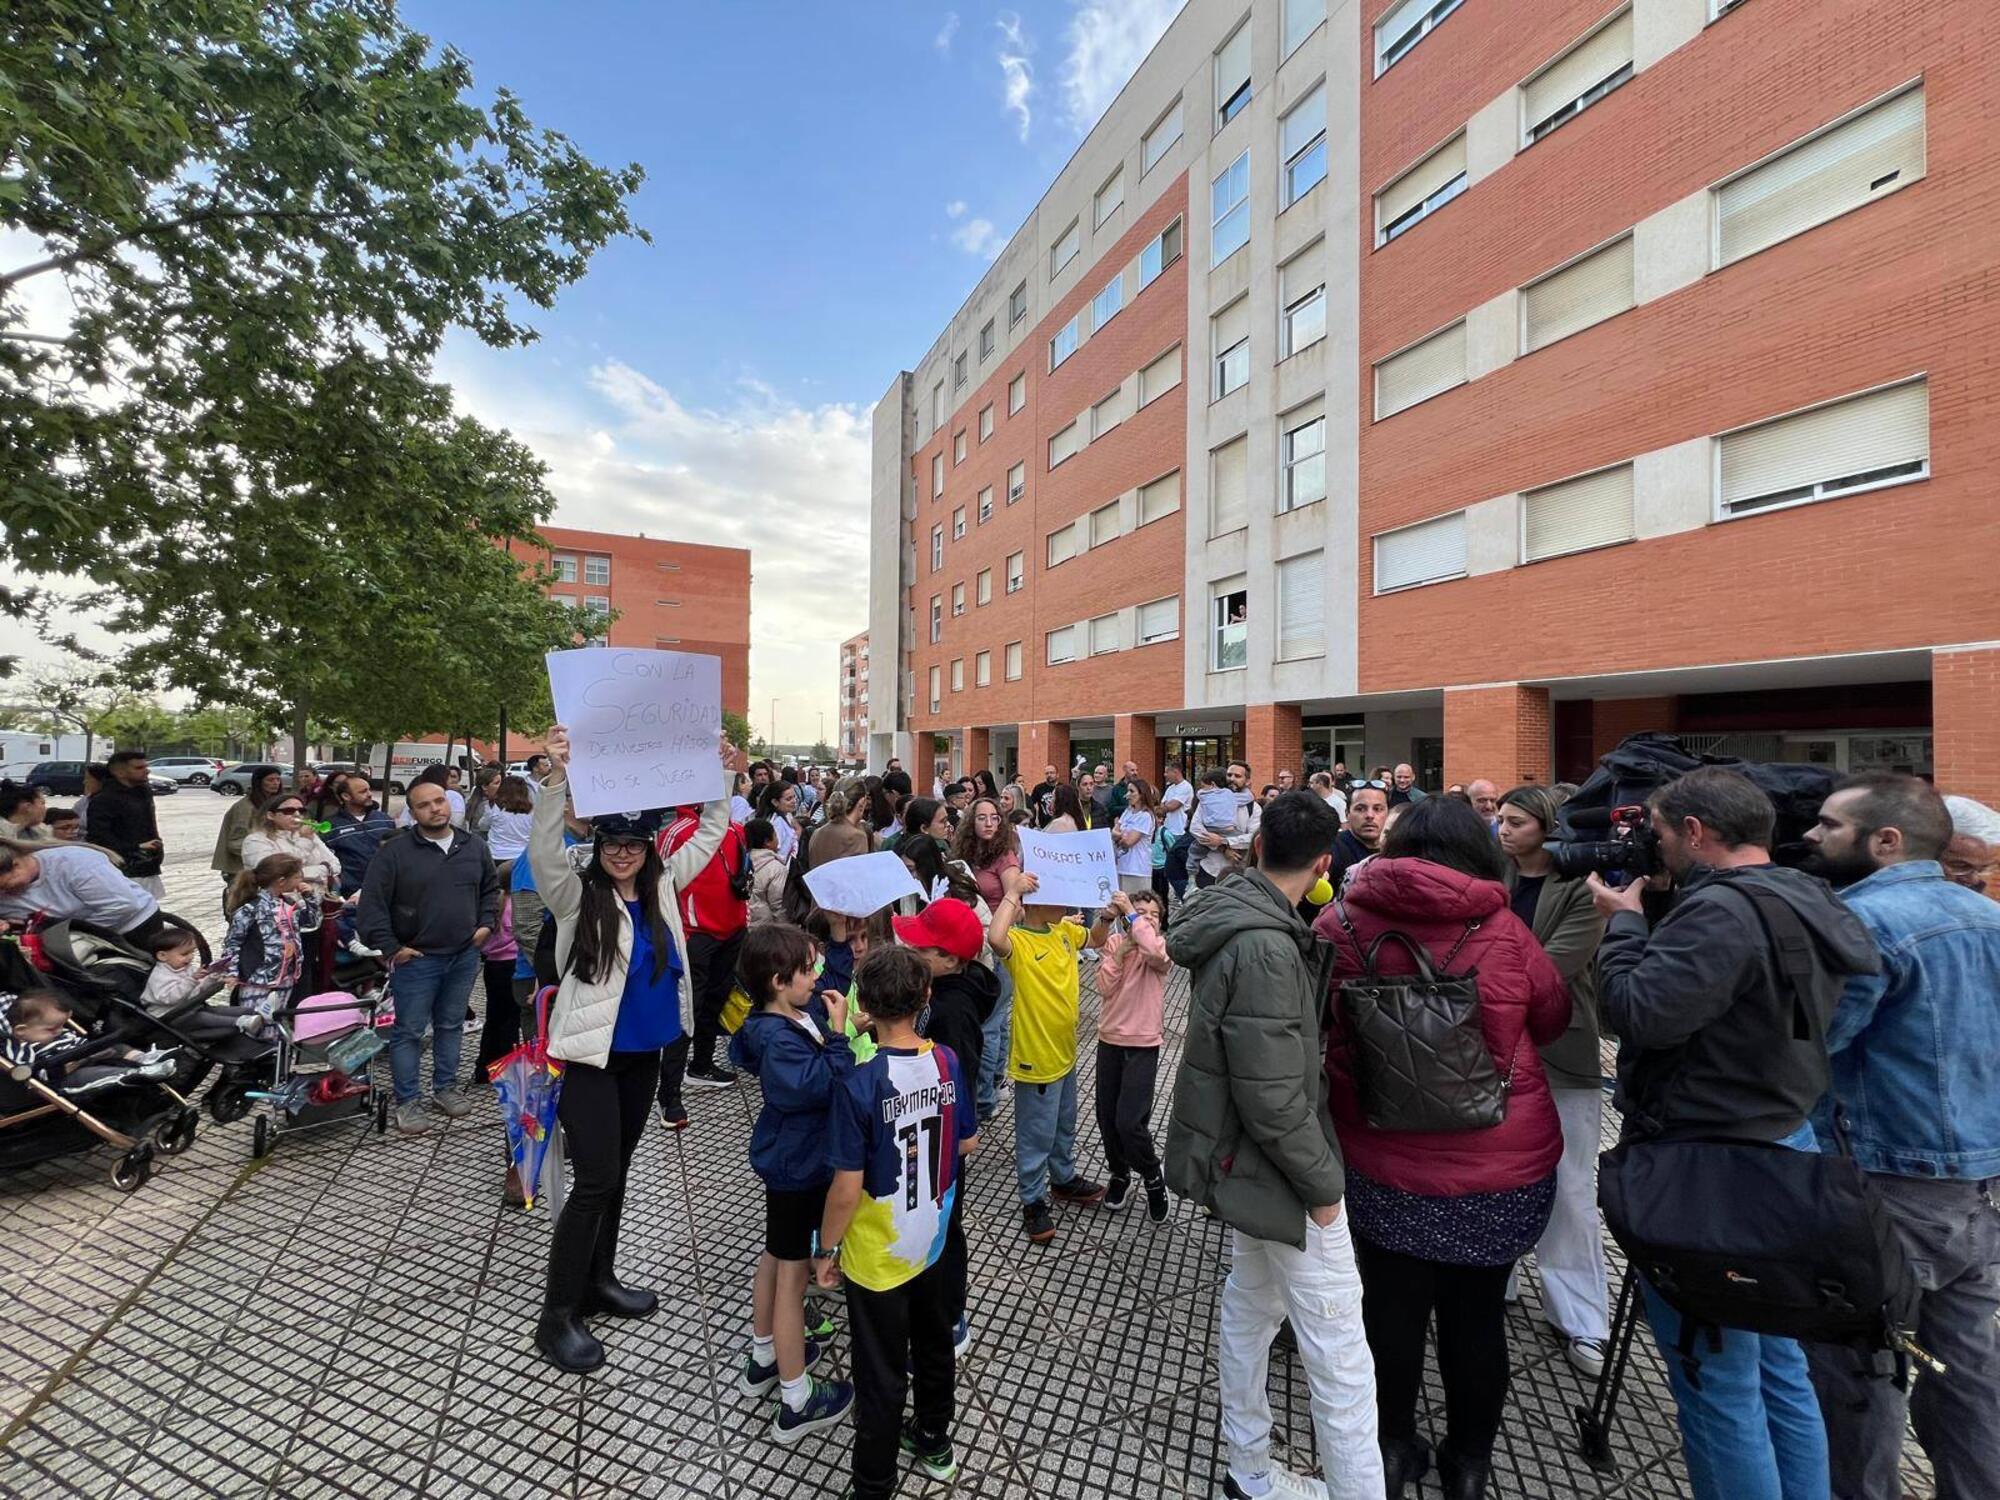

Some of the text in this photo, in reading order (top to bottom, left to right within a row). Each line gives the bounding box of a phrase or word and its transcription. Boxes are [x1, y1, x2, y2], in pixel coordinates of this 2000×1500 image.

[612, 652, 695, 680] CON LA
[589, 740, 611, 759] DE
[882, 1082, 956, 1123] NEYMAR JR
[898, 1114, 944, 1212] 11
